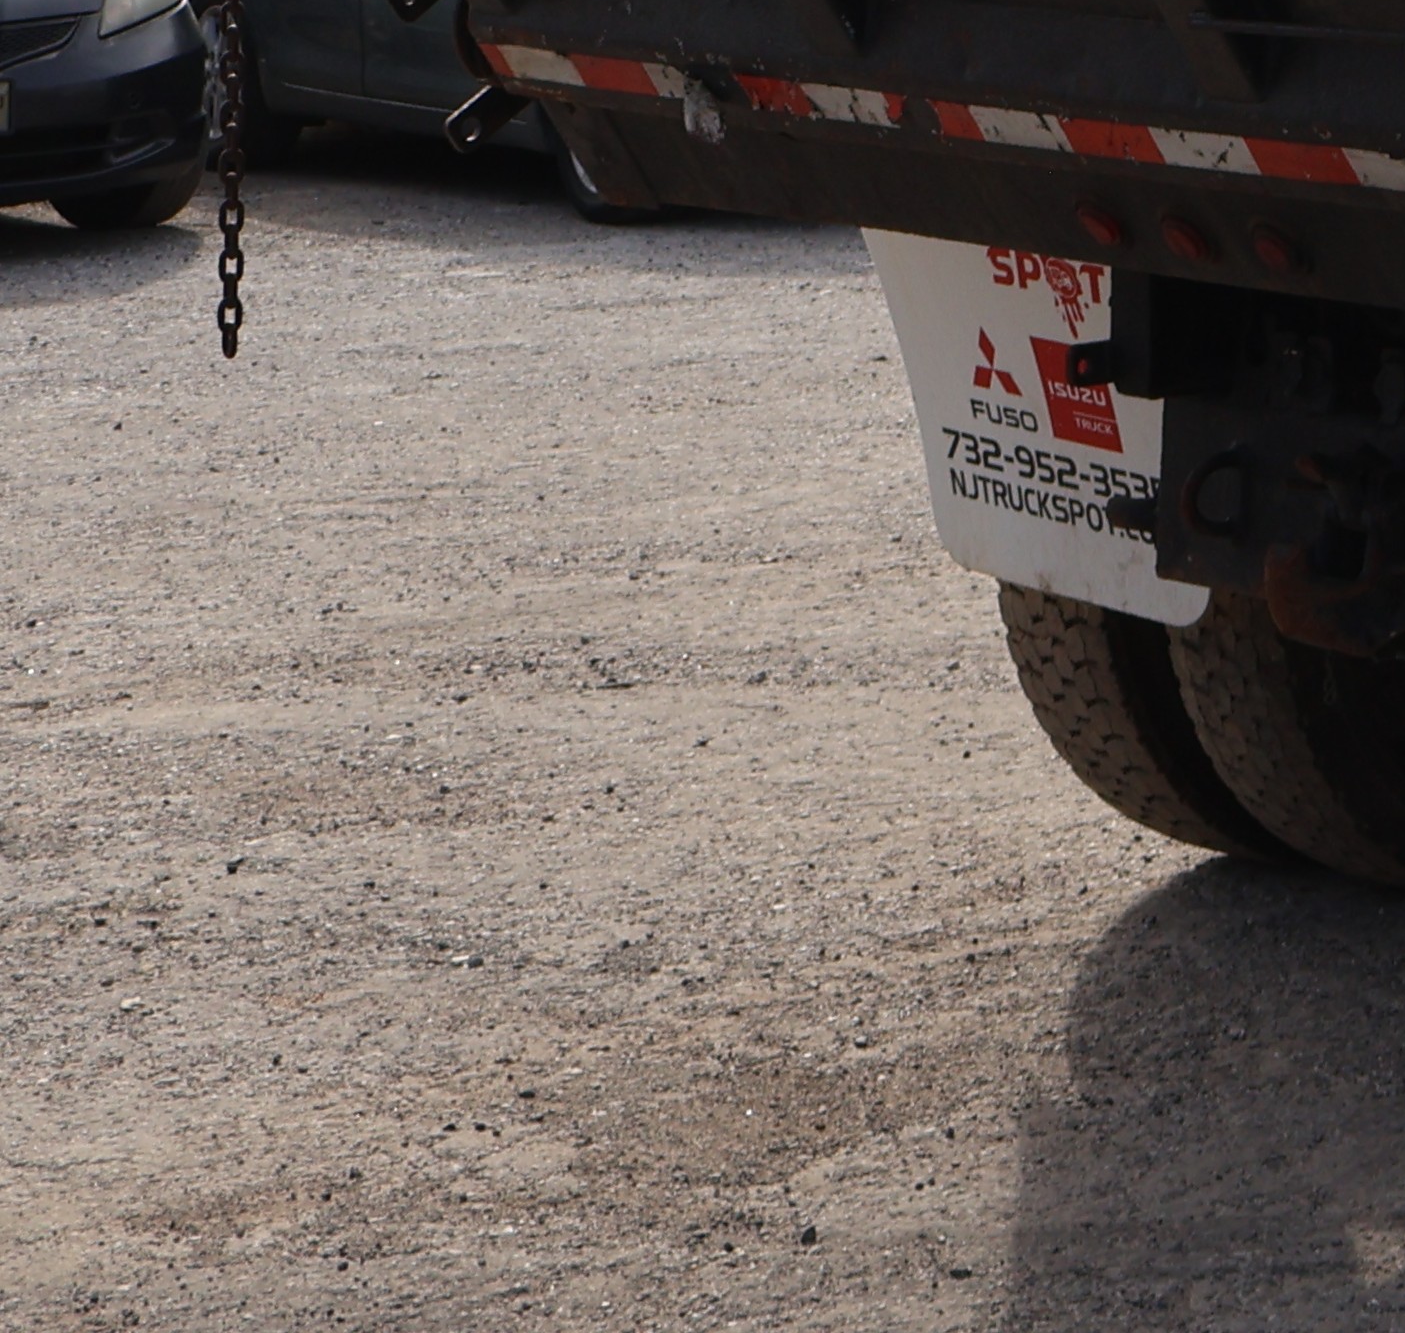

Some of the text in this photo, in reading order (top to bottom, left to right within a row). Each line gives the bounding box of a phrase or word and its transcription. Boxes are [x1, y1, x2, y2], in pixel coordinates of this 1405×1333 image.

[987, 245, 1105, 305] SPOT
[1048, 379, 1107, 407] ISUZU
[970, 399, 1039, 433] FUSO
[1074, 417, 1115, 435] TRUCK
